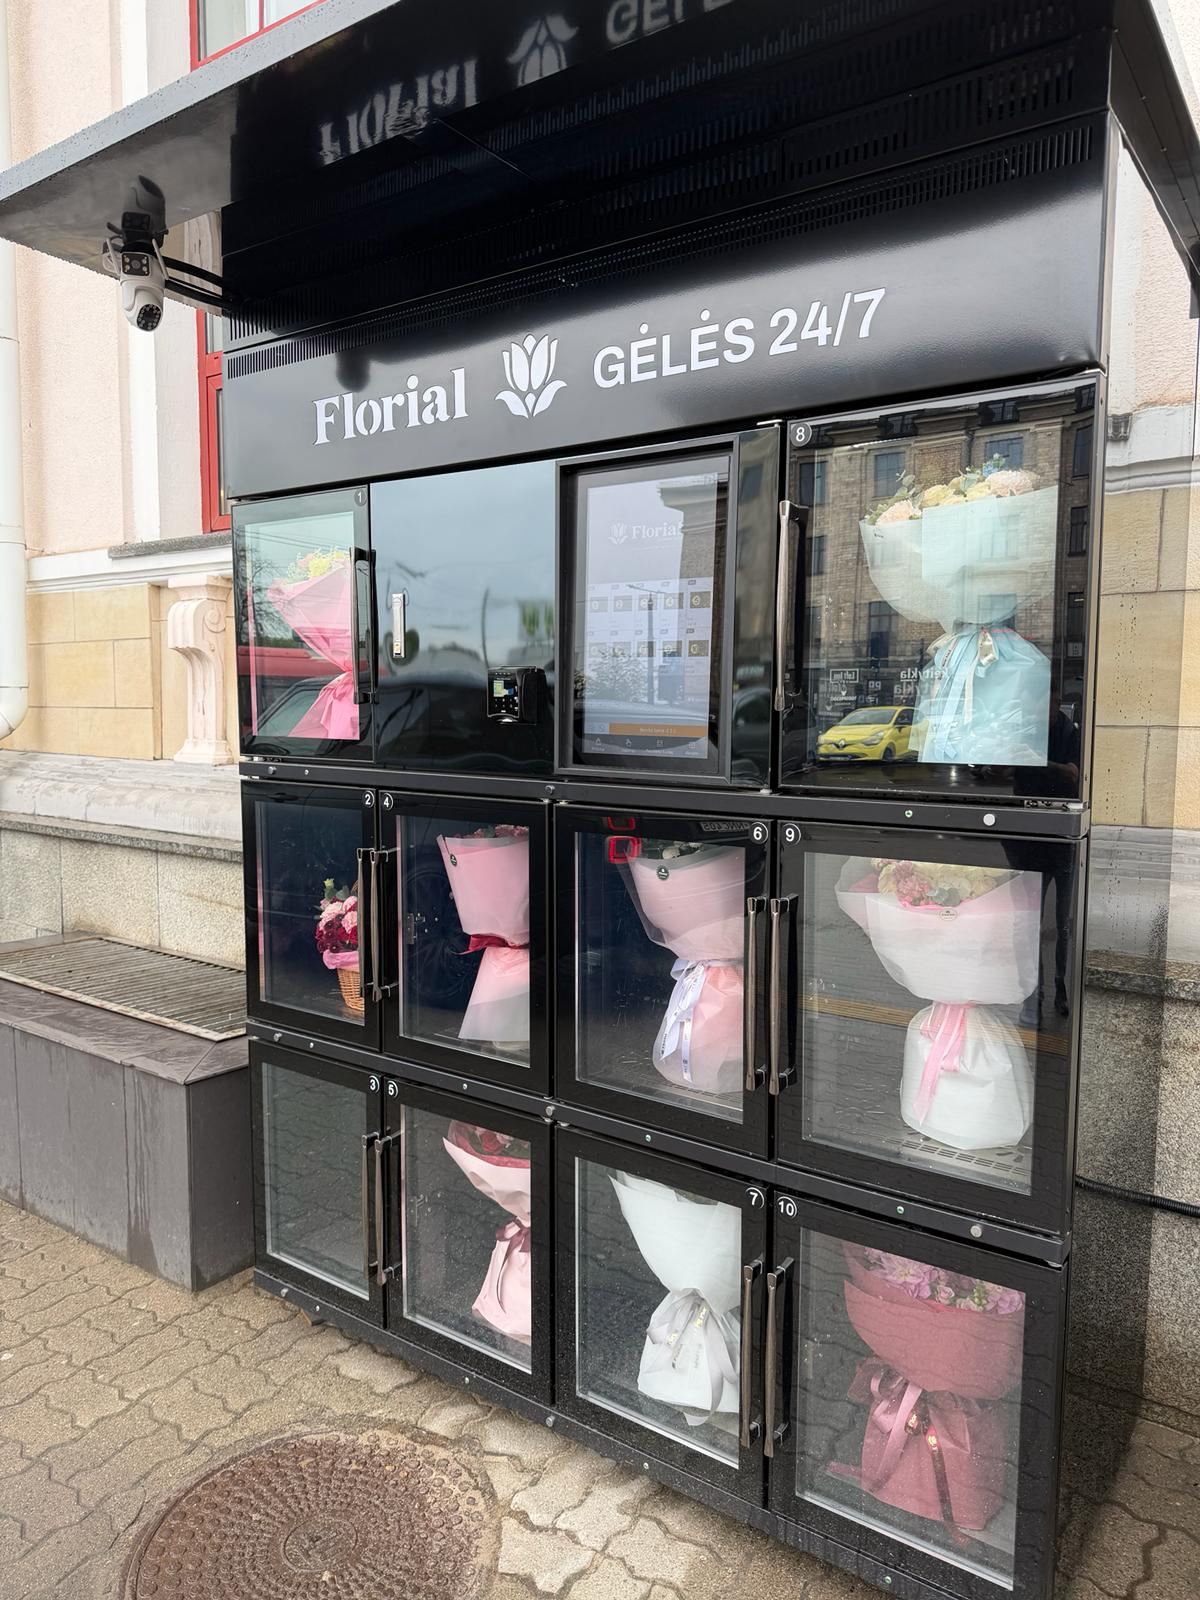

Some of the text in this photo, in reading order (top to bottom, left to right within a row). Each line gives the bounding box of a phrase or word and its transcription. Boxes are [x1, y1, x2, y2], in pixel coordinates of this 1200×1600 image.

[312, 287, 887, 446] Florial GĖLĖS 24/7
[796, 426, 805, 442] 8
[753, 826, 763, 840] 6
[785, 827, 795, 842] 9
[749, 1191, 758, 1206] 7
[778, 1200, 794, 1216] 10
